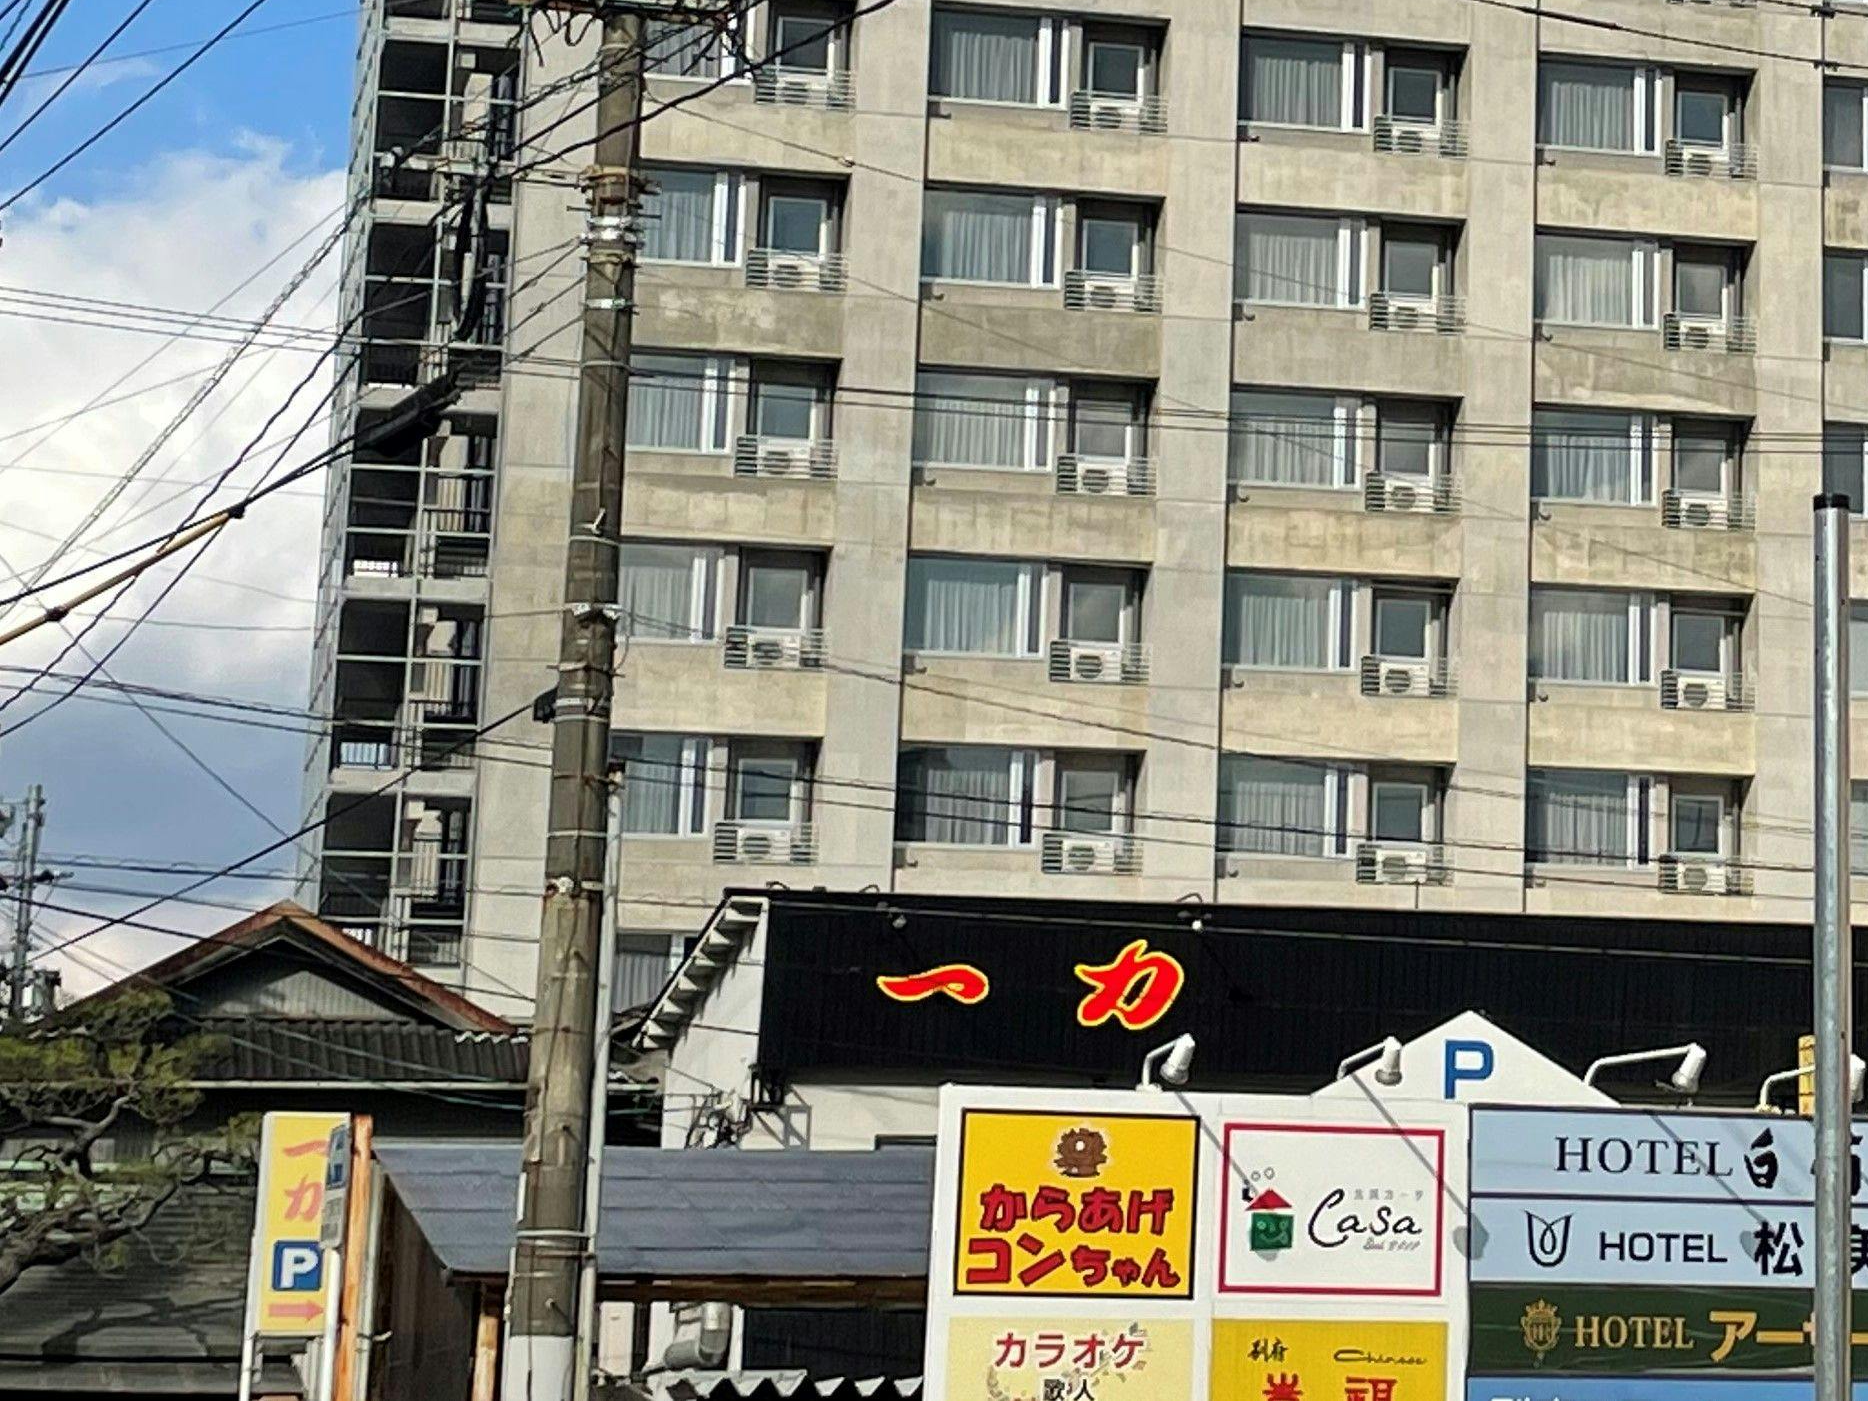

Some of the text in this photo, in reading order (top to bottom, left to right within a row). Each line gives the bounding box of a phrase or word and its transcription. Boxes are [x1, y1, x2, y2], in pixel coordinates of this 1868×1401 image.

[1444, 1039, 1494, 1100] P
[1555, 1136, 1733, 1177] HOTEL
[980, 1184, 1174, 1236] からあげ
[1308, 1188, 1423, 1247] Casa
[966, 1232, 1181, 1289] コンちゃん
[1600, 1231, 1728, 1263] HOTEL
[280, 1248, 319, 1289] P
[994, 1332, 1144, 1368] カラオケ
[1574, 1315, 1695, 1350] HOTEL
